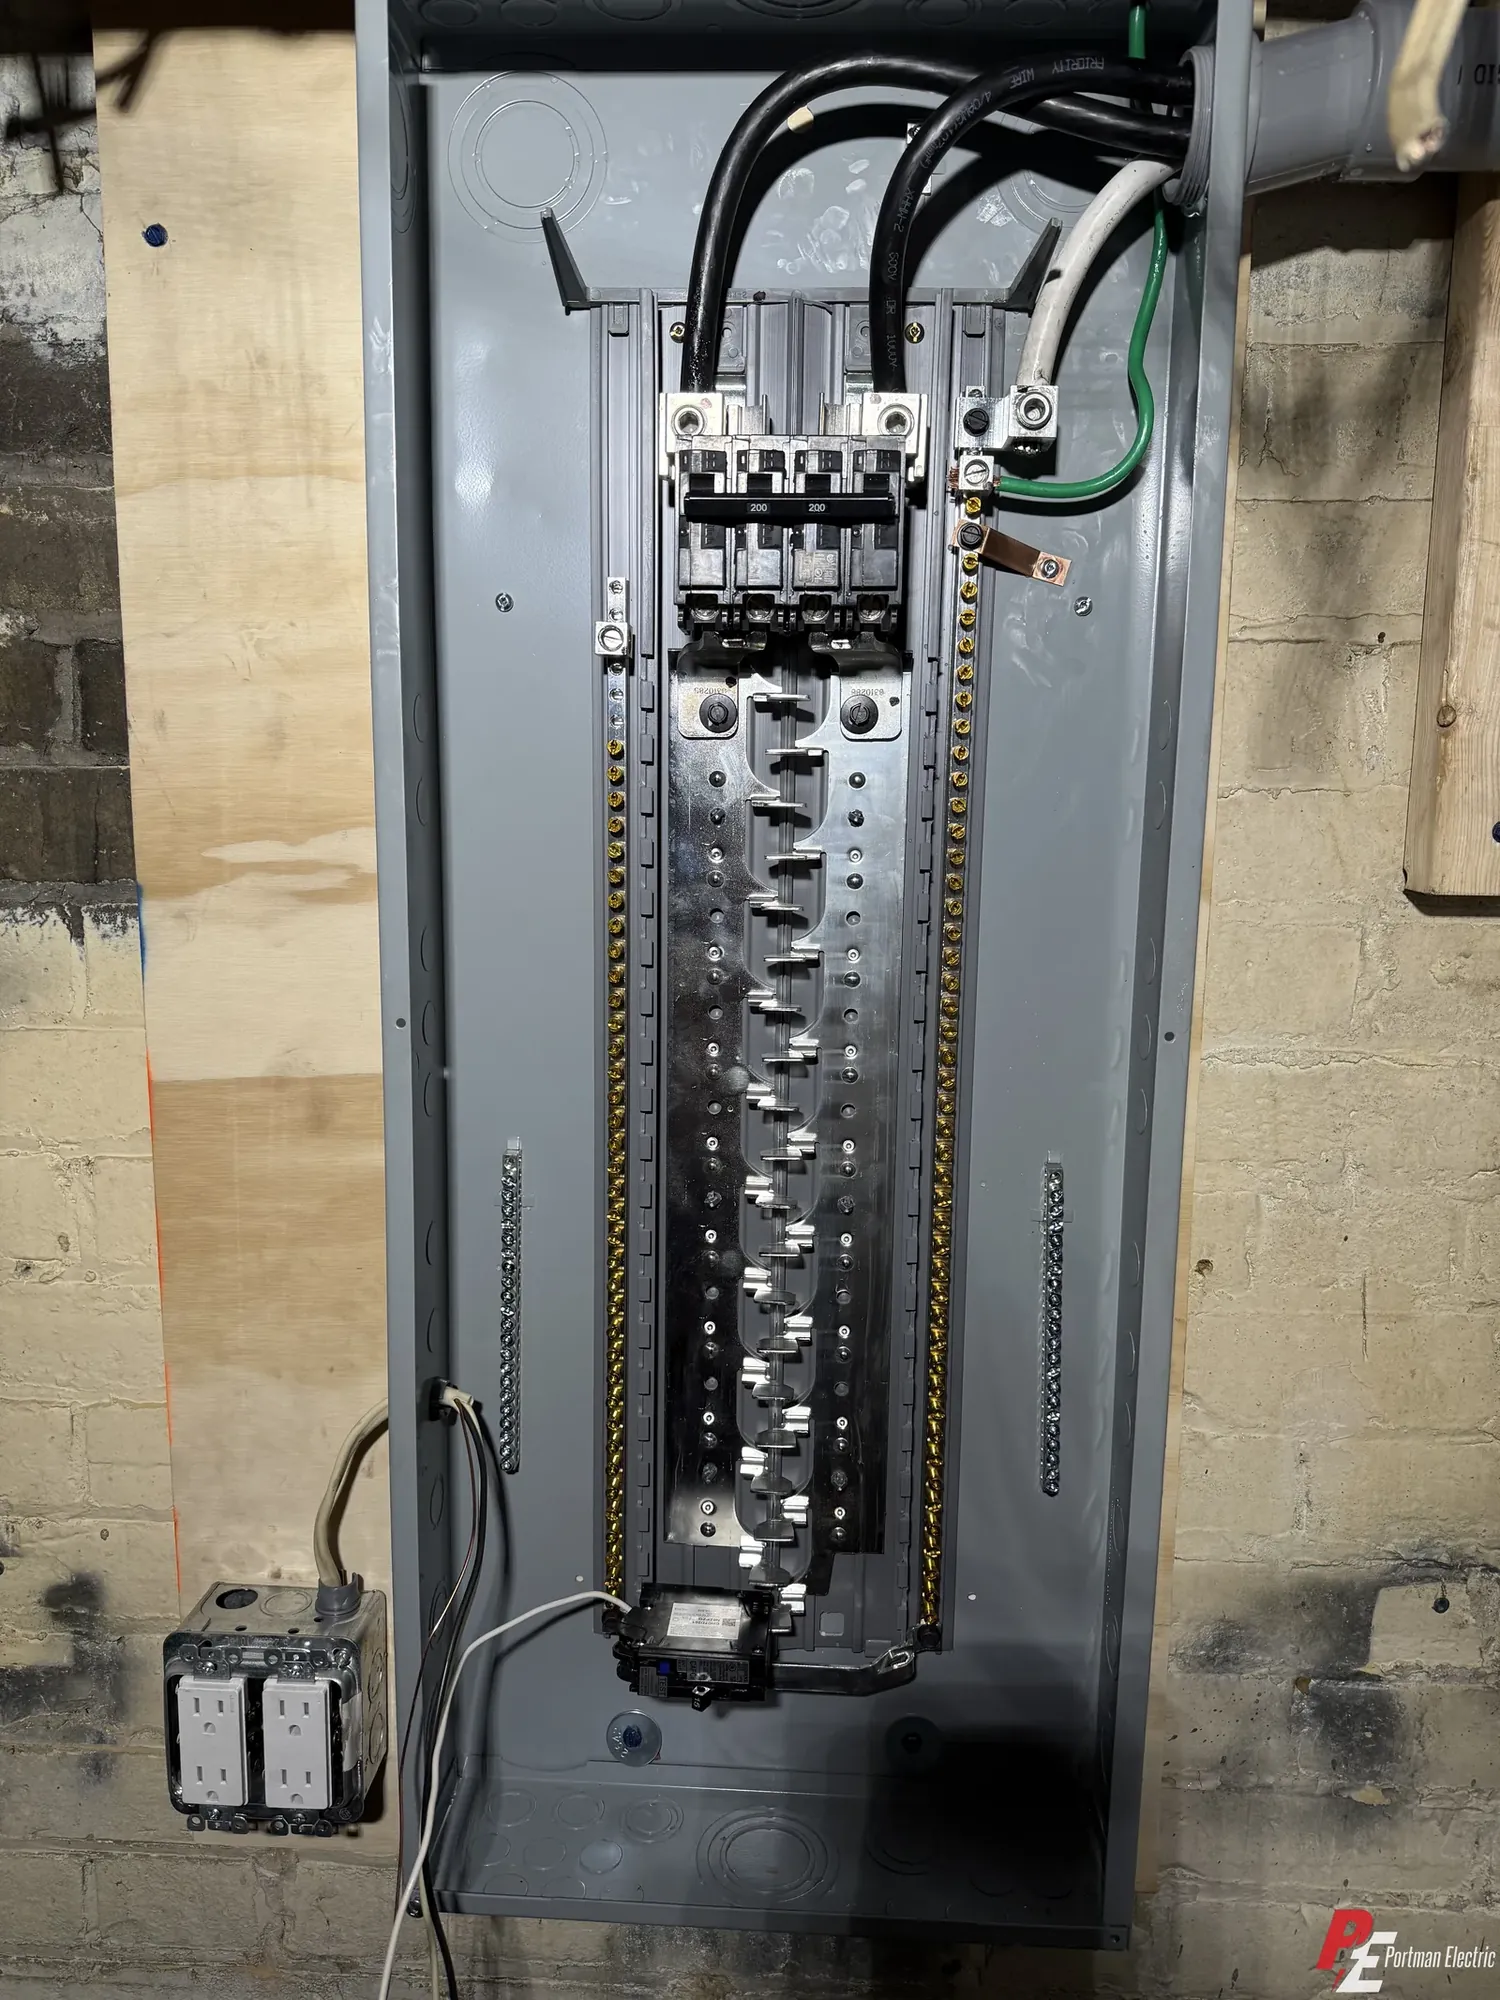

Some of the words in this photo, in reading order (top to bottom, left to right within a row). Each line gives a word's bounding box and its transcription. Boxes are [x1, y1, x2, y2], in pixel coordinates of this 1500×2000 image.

[1051, 56, 1105, 75] PRIORITY
[1008, 67, 1035, 90] WIRE
[750, 503, 768, 512] 200
[808, 503, 826, 512] 200
[659, 1676, 667, 1697] TEST
[693, 1698, 700, 1708] 15
